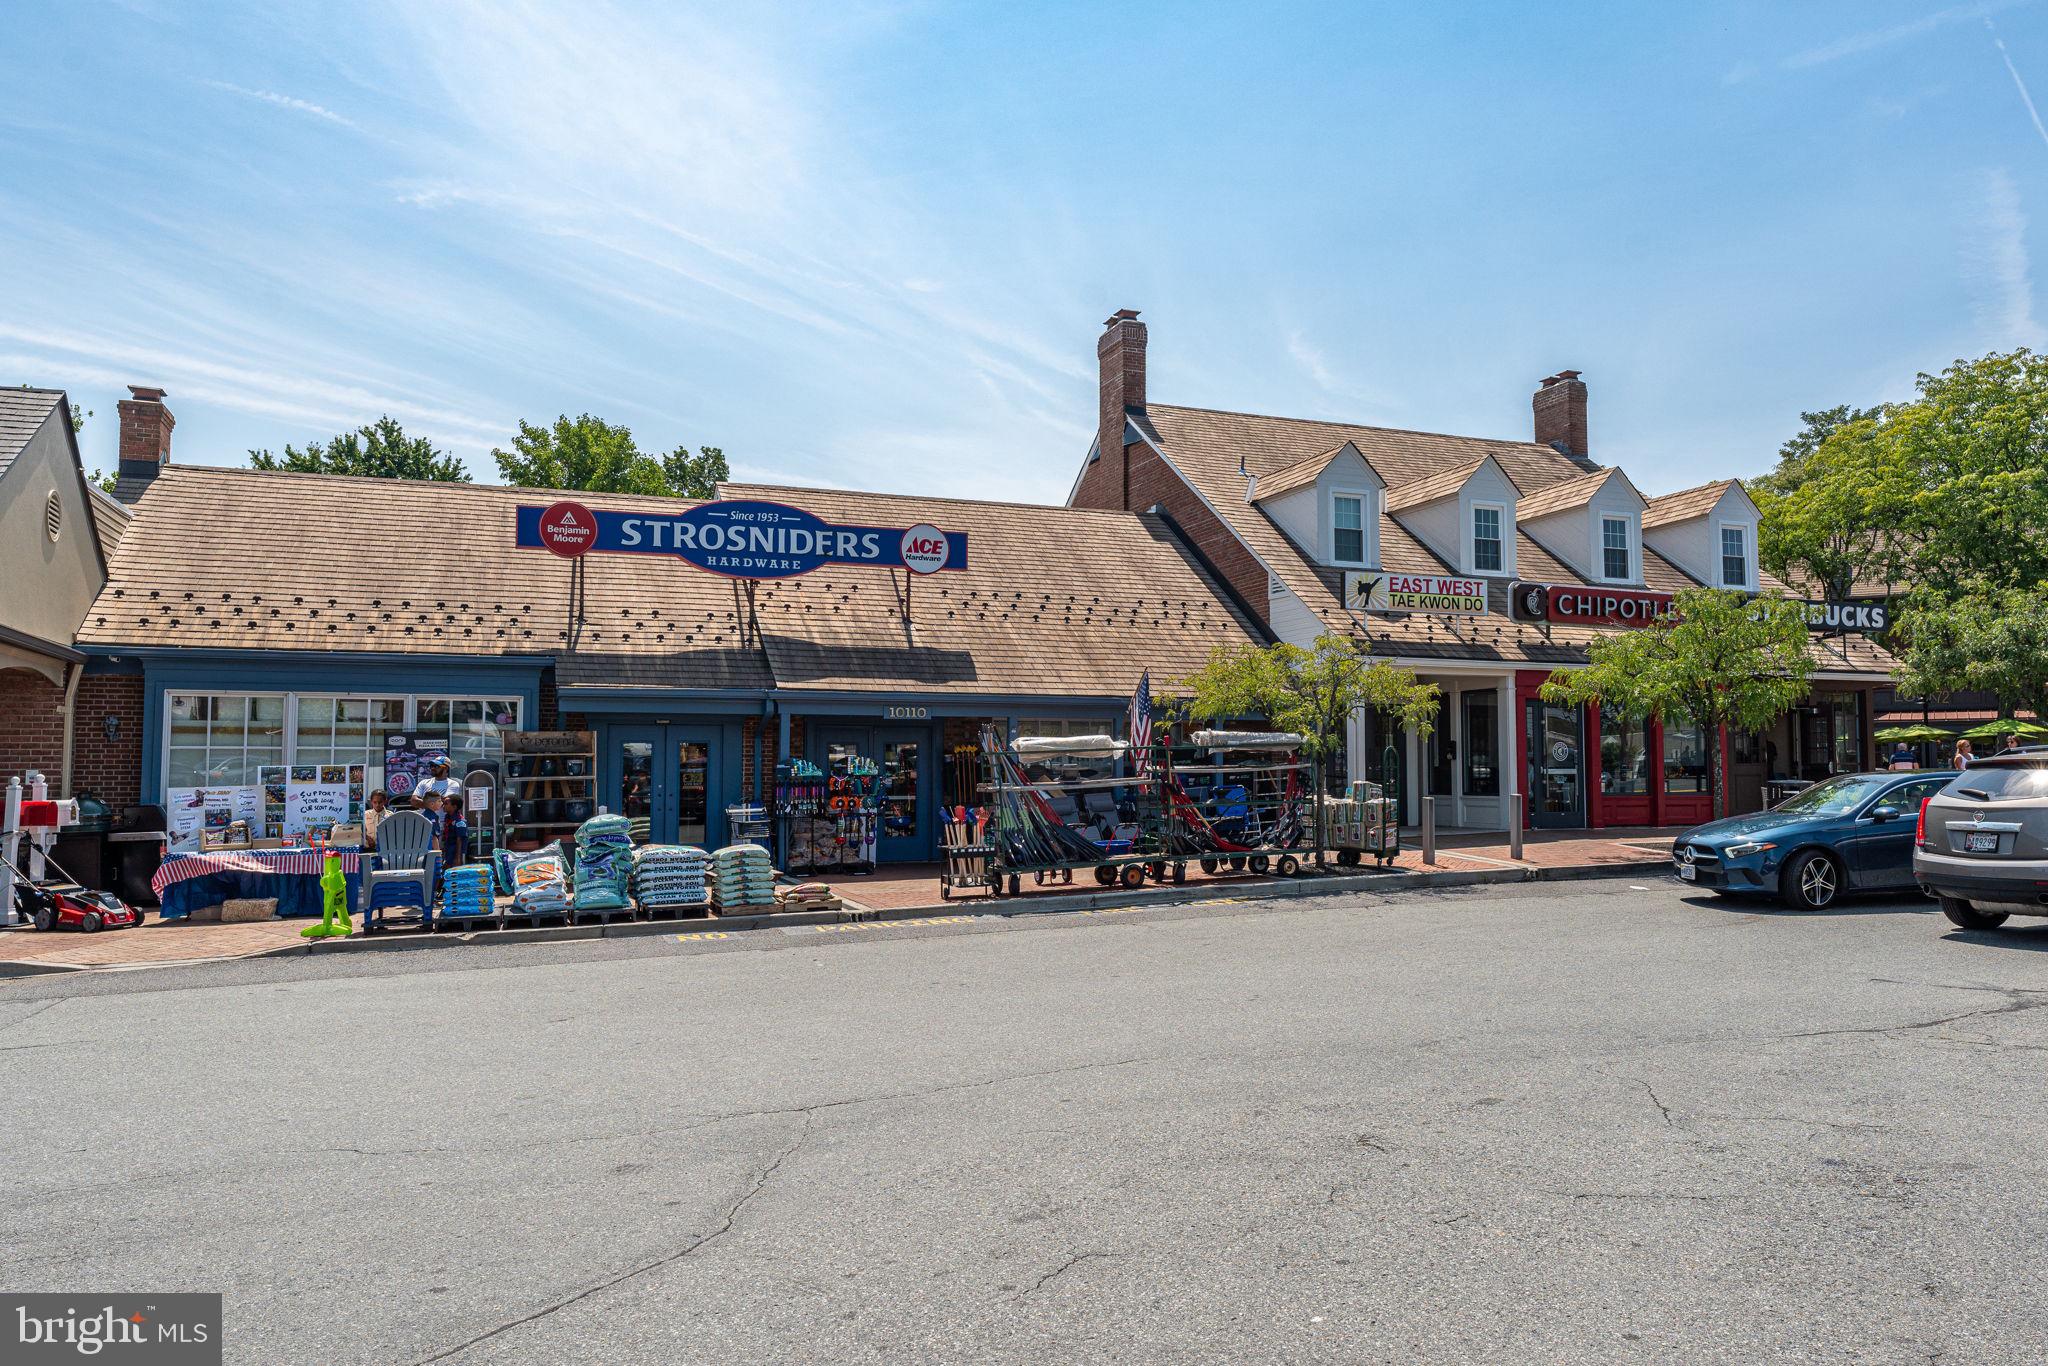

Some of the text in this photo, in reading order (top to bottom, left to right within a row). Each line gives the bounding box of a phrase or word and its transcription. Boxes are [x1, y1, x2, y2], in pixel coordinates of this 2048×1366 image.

[730, 510, 779, 523] Since 1953
[547, 524, 590, 536] Benjamin
[553, 534, 584, 544] Moore
[620, 519, 880, 559] STROSNIDERS
[905, 536, 944, 555] ACE
[707, 556, 802, 571] HARDWARE
[905, 553, 942, 562] Hardware
[1389, 576, 1484, 597] EAST WEST
[1389, 594, 1483, 611] TAE KWON DO
[1558, 594, 1680, 622] CHIPOTLE
[889, 707, 927, 718] 10110
[300, 790, 336, 798] SUPPORT
[676, 914, 975, 943] NO PARKING
